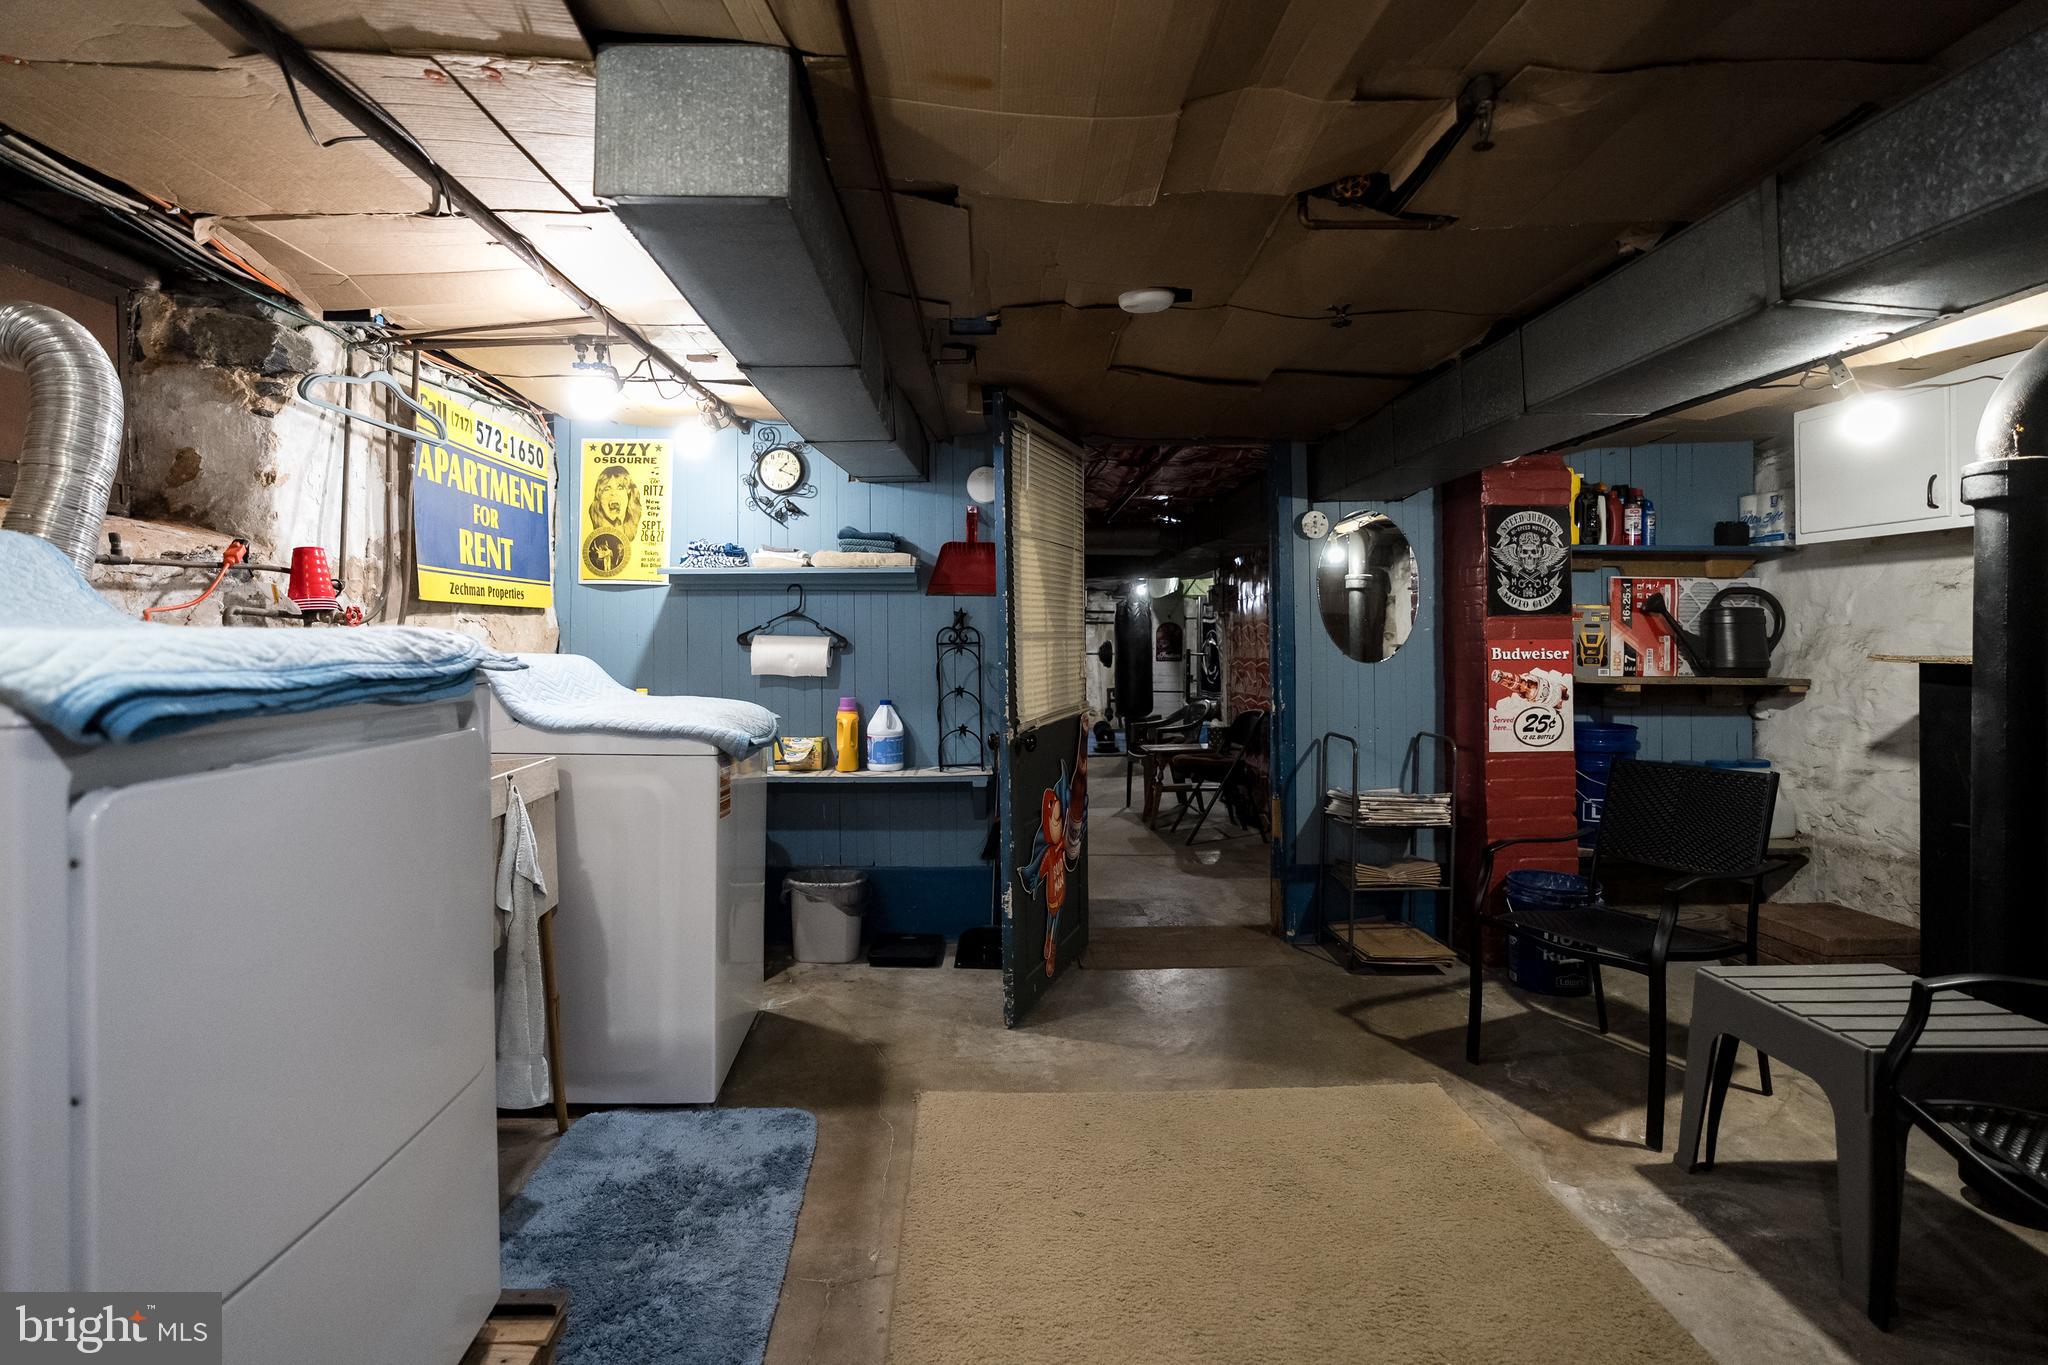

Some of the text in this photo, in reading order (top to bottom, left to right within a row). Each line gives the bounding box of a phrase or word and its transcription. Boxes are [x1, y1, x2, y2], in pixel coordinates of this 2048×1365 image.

[451, 410, 473, 434] (717)
[476, 420, 544, 469] 572-1650
[601, 443, 651, 456] OZZY
[594, 456, 657, 464] OSBOURNE
[417, 442, 546, 514] APARTMENT
[643, 484, 664, 497] RITZ
[473, 503, 499, 529] FOR
[642, 520, 664, 530] SEPT.
[1500, 513, 1560, 534] SPEED JUNKIES
[641, 530, 665, 542] 26 & 27
[459, 528, 513, 571] RENT
[1543, 577, 1548, 585] C
[449, 582, 525, 600] Zechman Properties
[1503, 591, 1529, 608] MOTO
[1532, 592, 1556, 609] CLUB
[1622, 583, 1632, 621] 16x25x1
[1491, 647, 1570, 660] Budweiser
[1624, 655, 1636, 664] 7
[1493, 715, 1515, 724] Served
